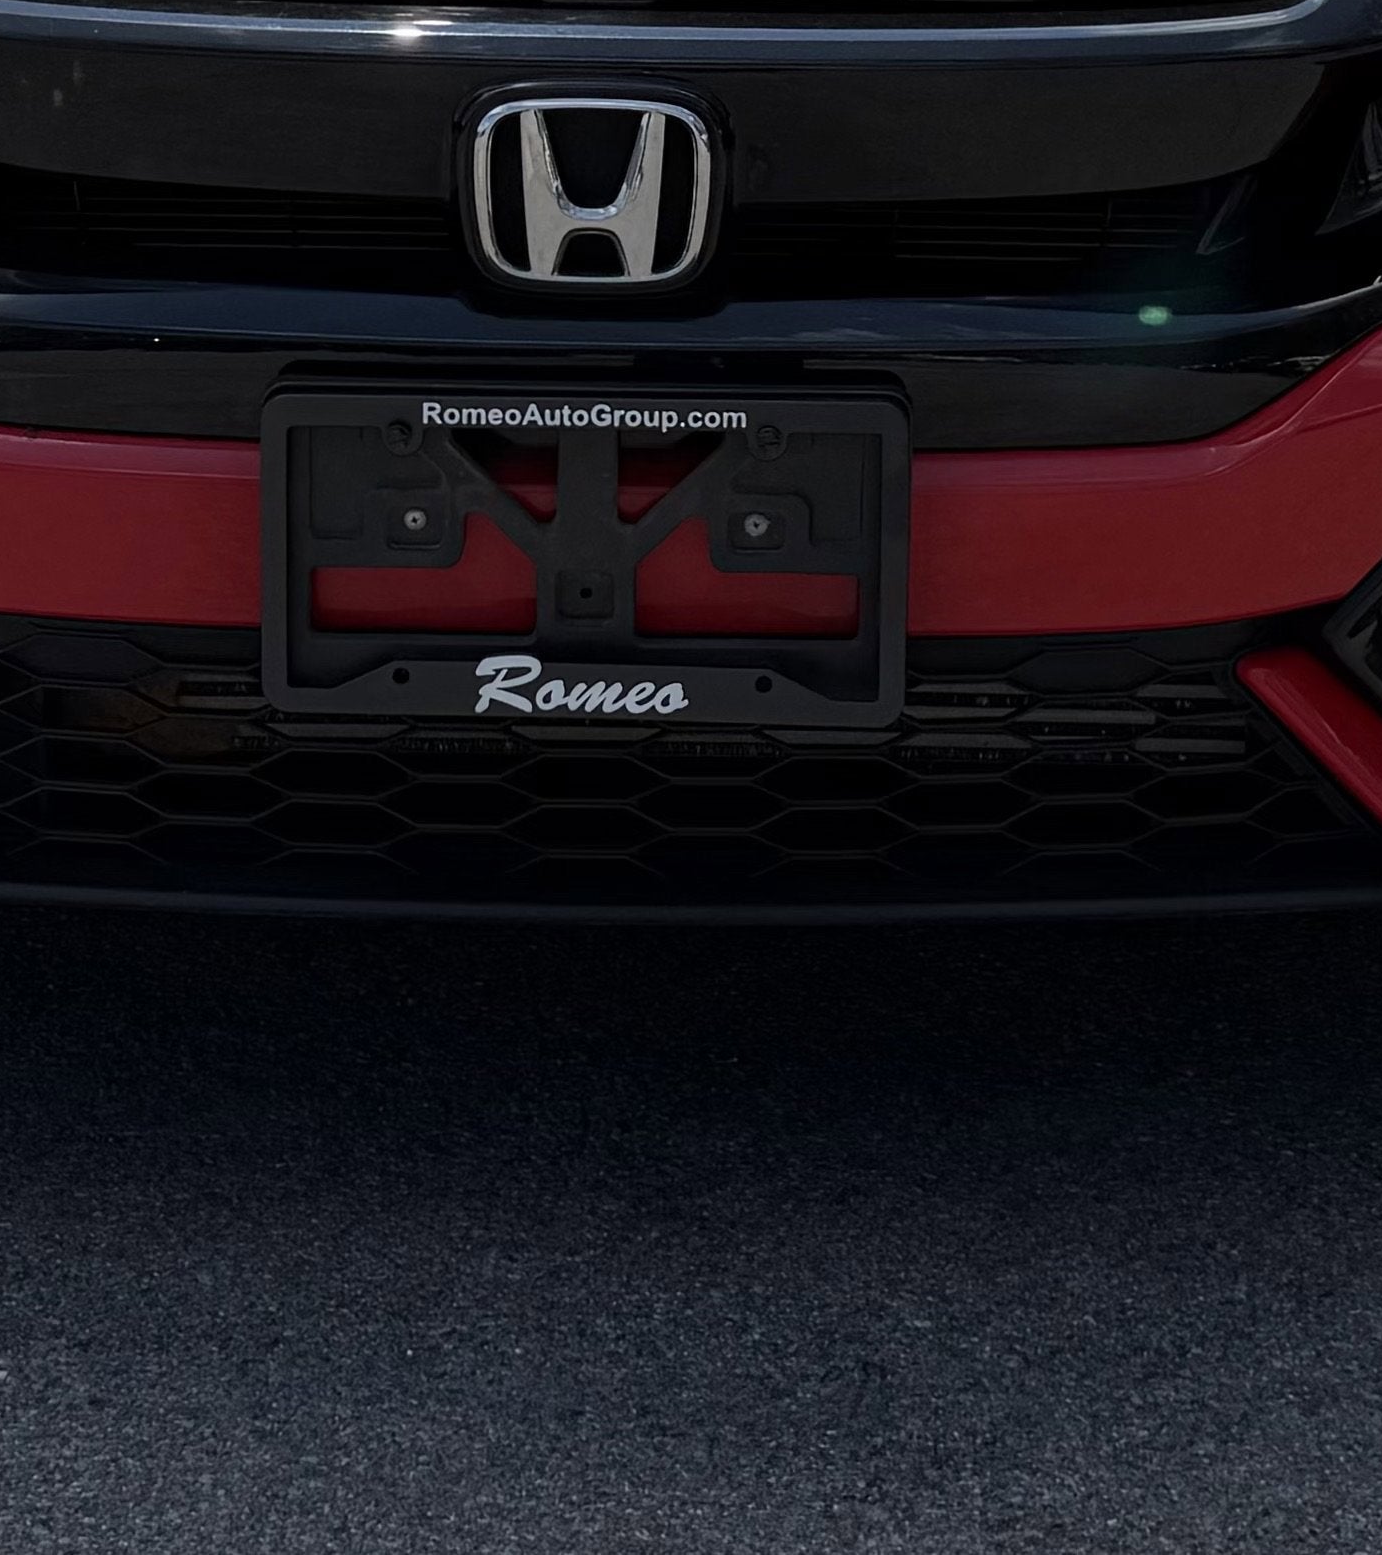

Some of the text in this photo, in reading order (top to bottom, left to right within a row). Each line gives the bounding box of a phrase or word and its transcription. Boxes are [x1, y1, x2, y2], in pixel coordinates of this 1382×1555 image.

[519, 107, 666, 276] H
[421, 401, 747, 433] RomeoAutoGroup.com
[474, 654, 689, 714] Romeo
